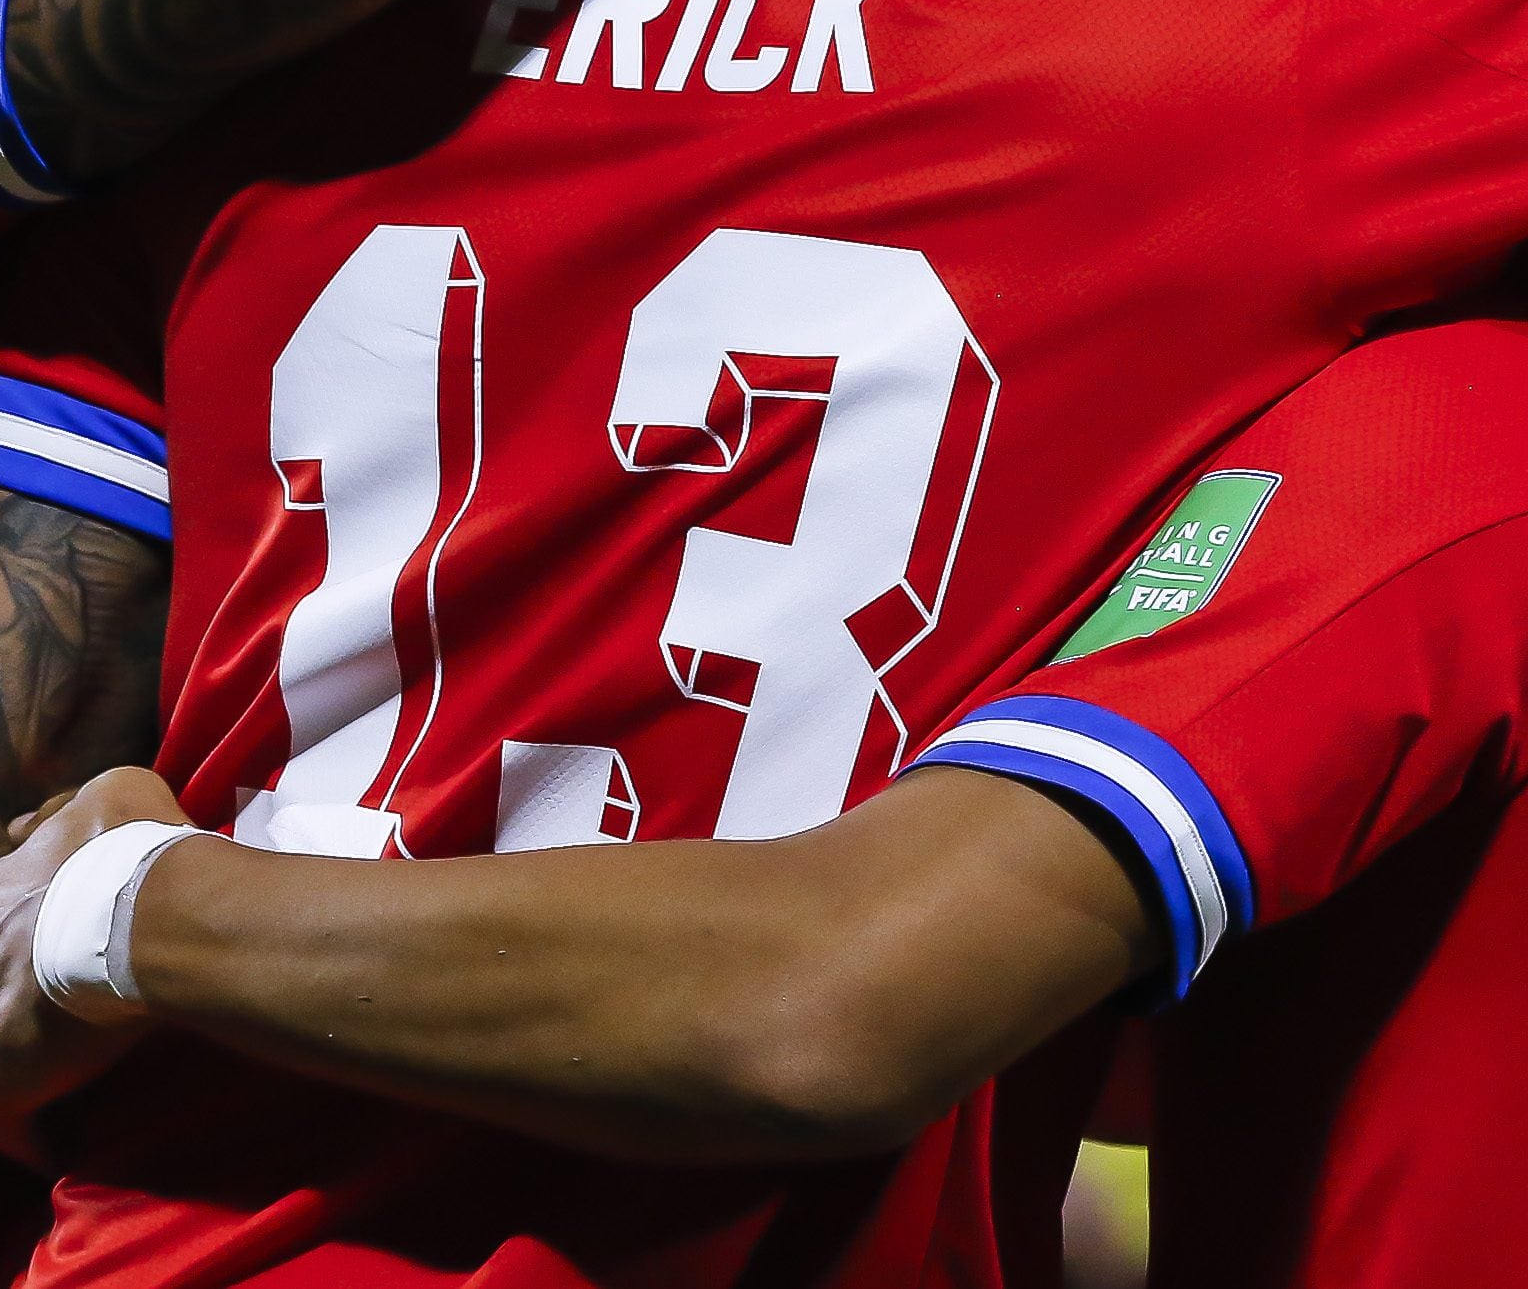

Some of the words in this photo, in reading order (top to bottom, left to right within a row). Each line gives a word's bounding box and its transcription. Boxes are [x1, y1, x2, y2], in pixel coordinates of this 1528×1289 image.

[235, 224, 1002, 861] 13
[1162, 522, 1232, 546] ING
[1128, 586, 1192, 612] FIFA
